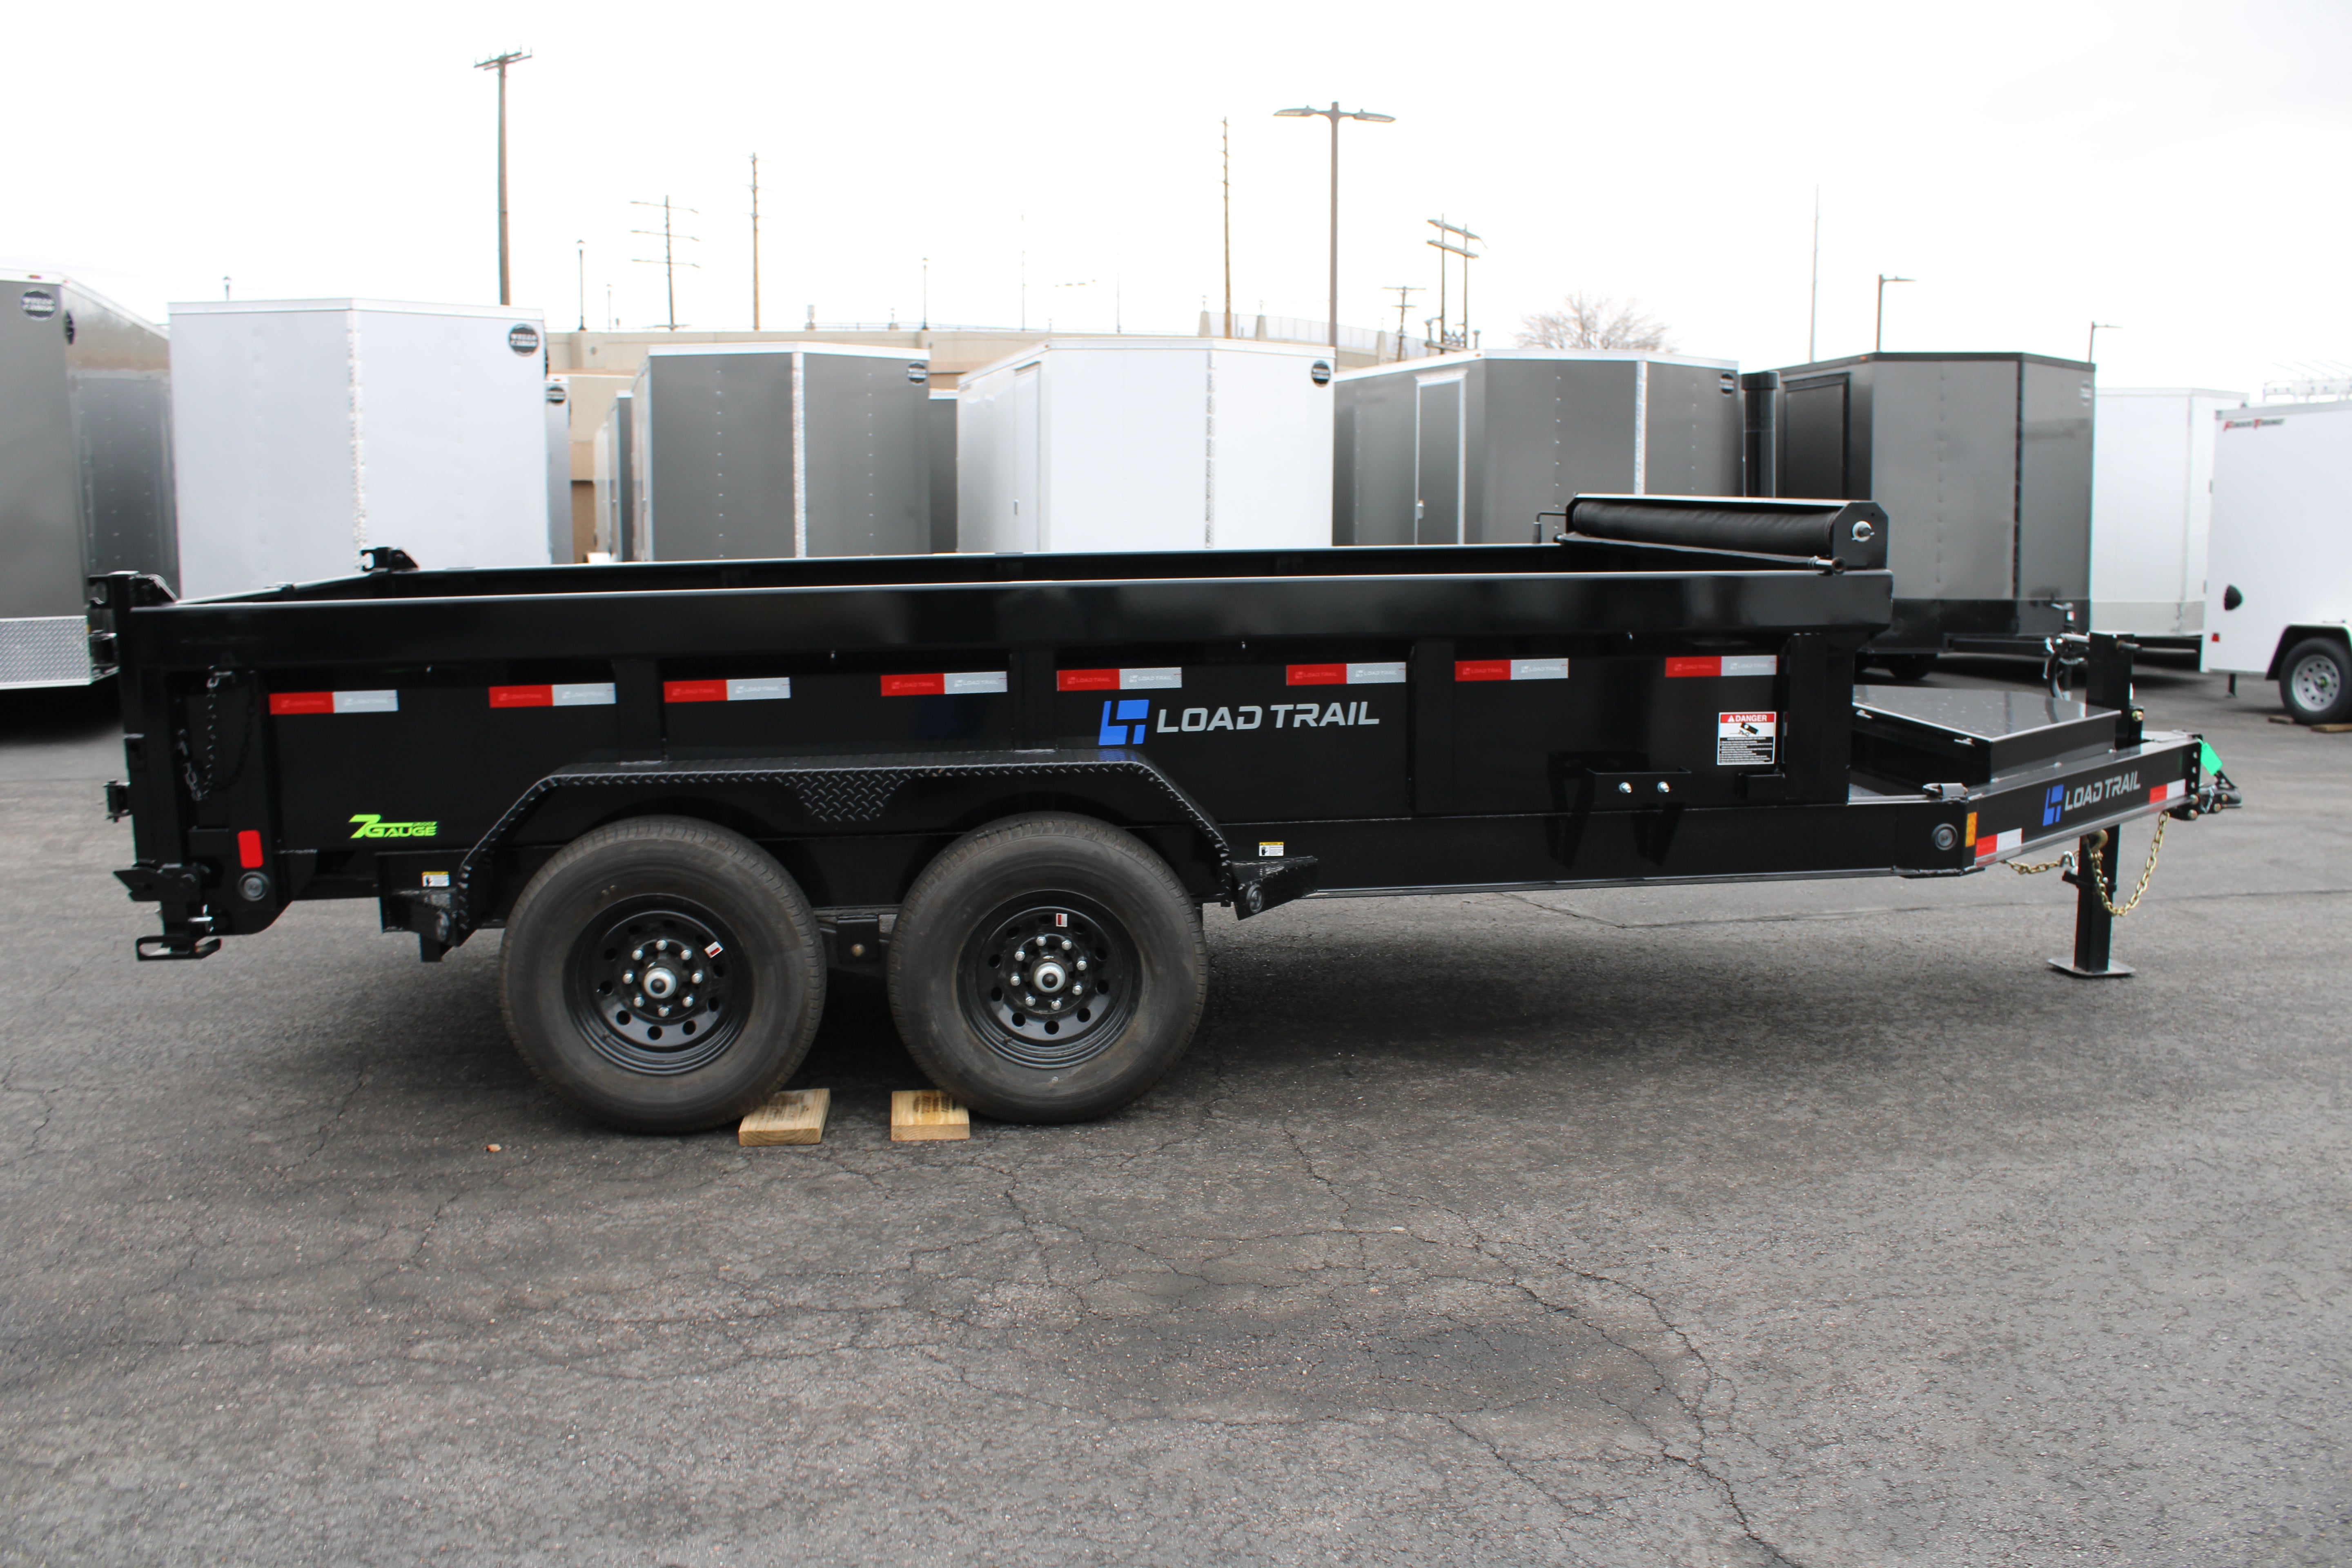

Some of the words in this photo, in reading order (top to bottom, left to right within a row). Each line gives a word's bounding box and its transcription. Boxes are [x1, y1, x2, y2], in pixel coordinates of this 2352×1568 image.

[1157, 706, 1262, 733] LOAD
[1271, 702, 1380, 728] TRAIL
[2065, 781, 2103, 811] LOAD
[2105, 771, 2141, 799] TRAIL
